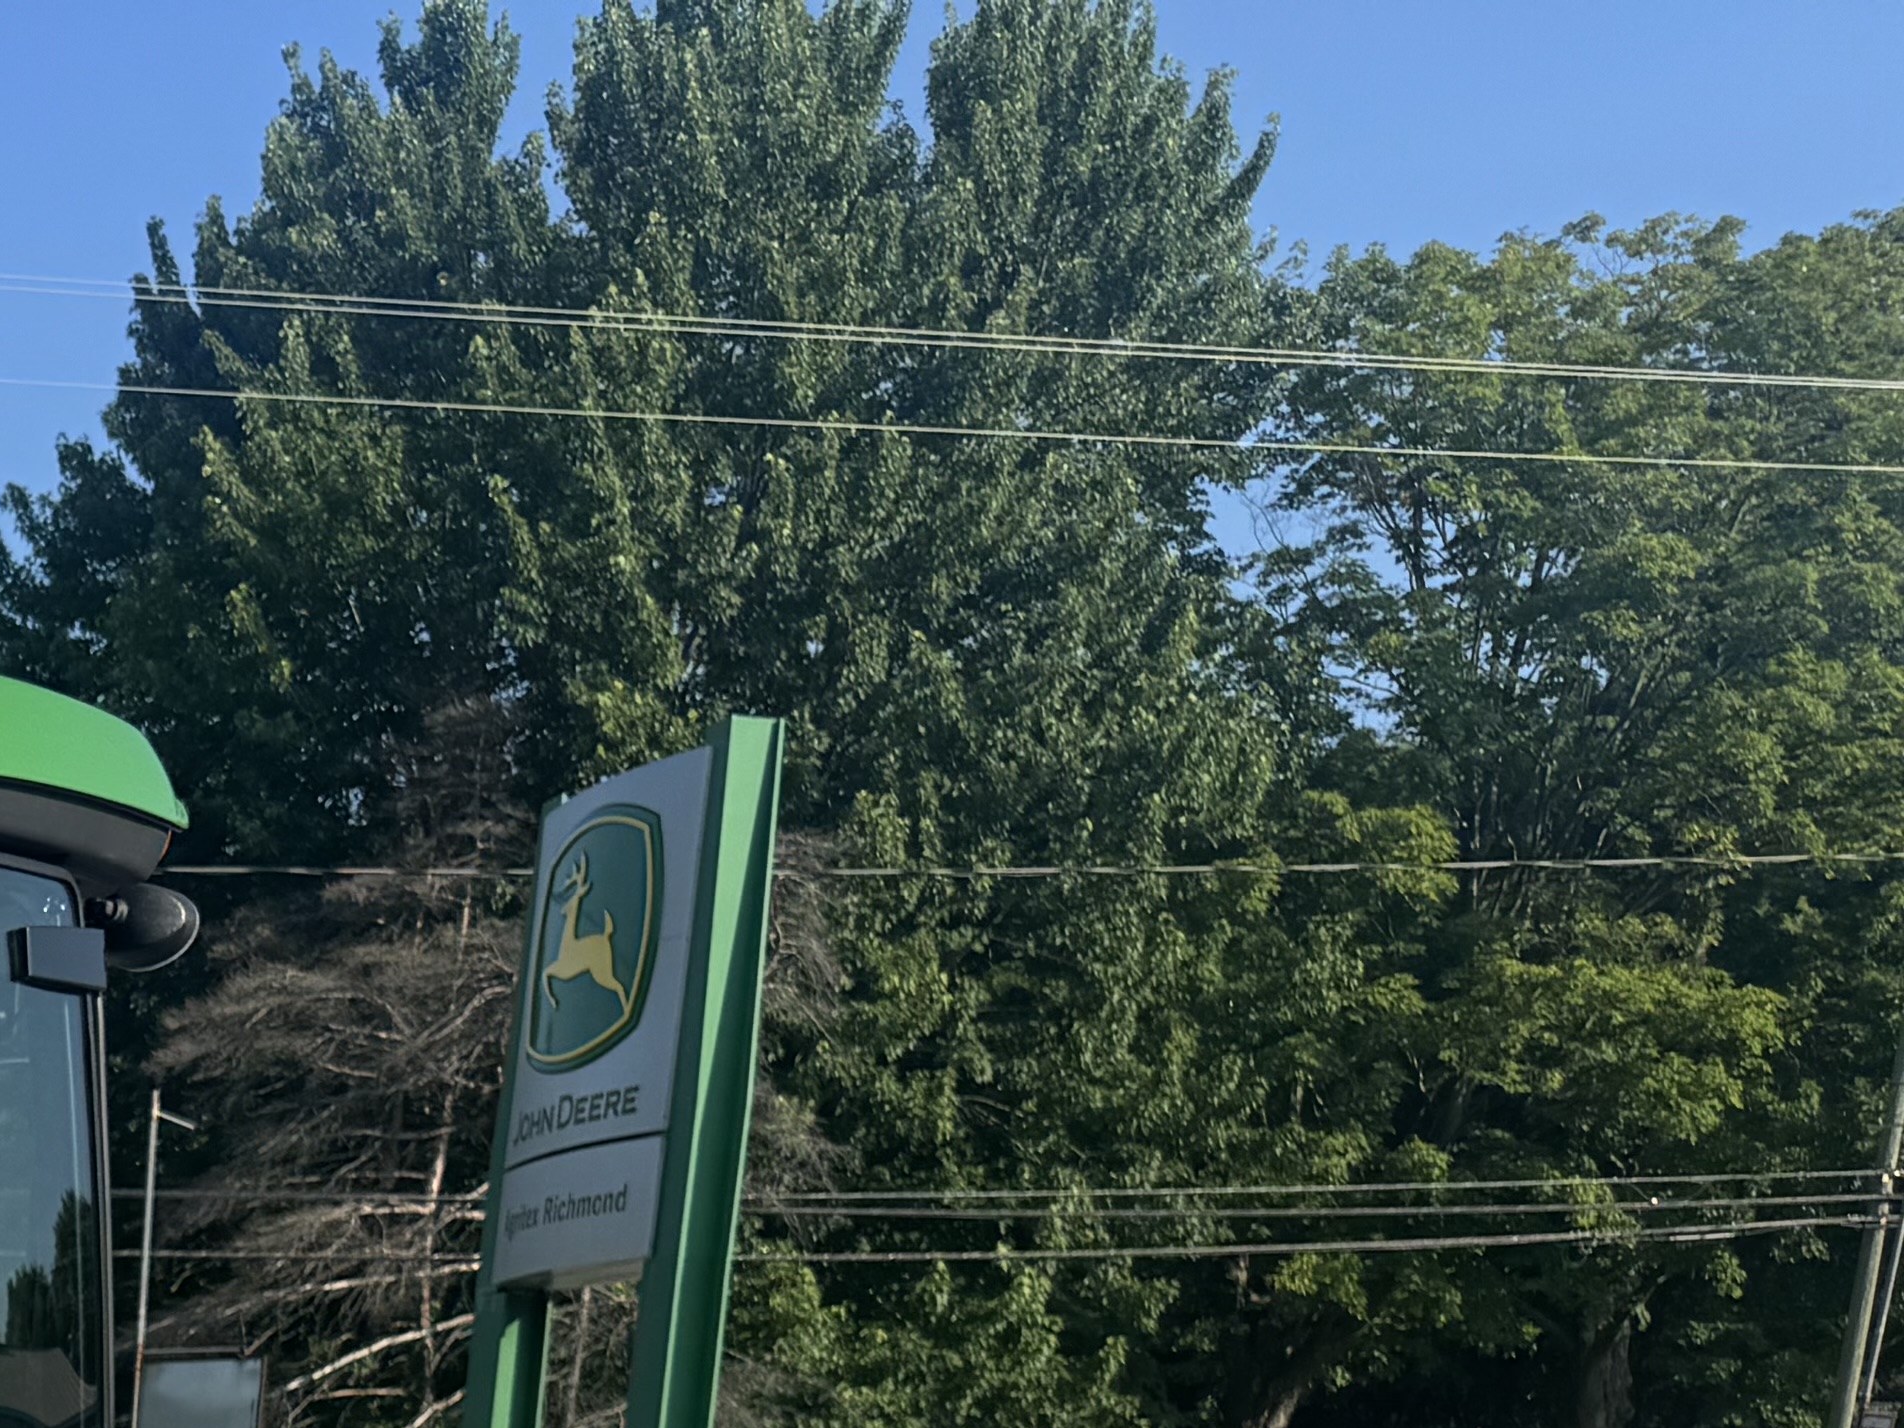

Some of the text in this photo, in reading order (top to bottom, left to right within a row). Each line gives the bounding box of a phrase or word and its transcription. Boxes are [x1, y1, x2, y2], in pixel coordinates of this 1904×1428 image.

[513, 1084, 640, 1147] JOHN DEERE
[542, 1183, 628, 1225] Richmond
